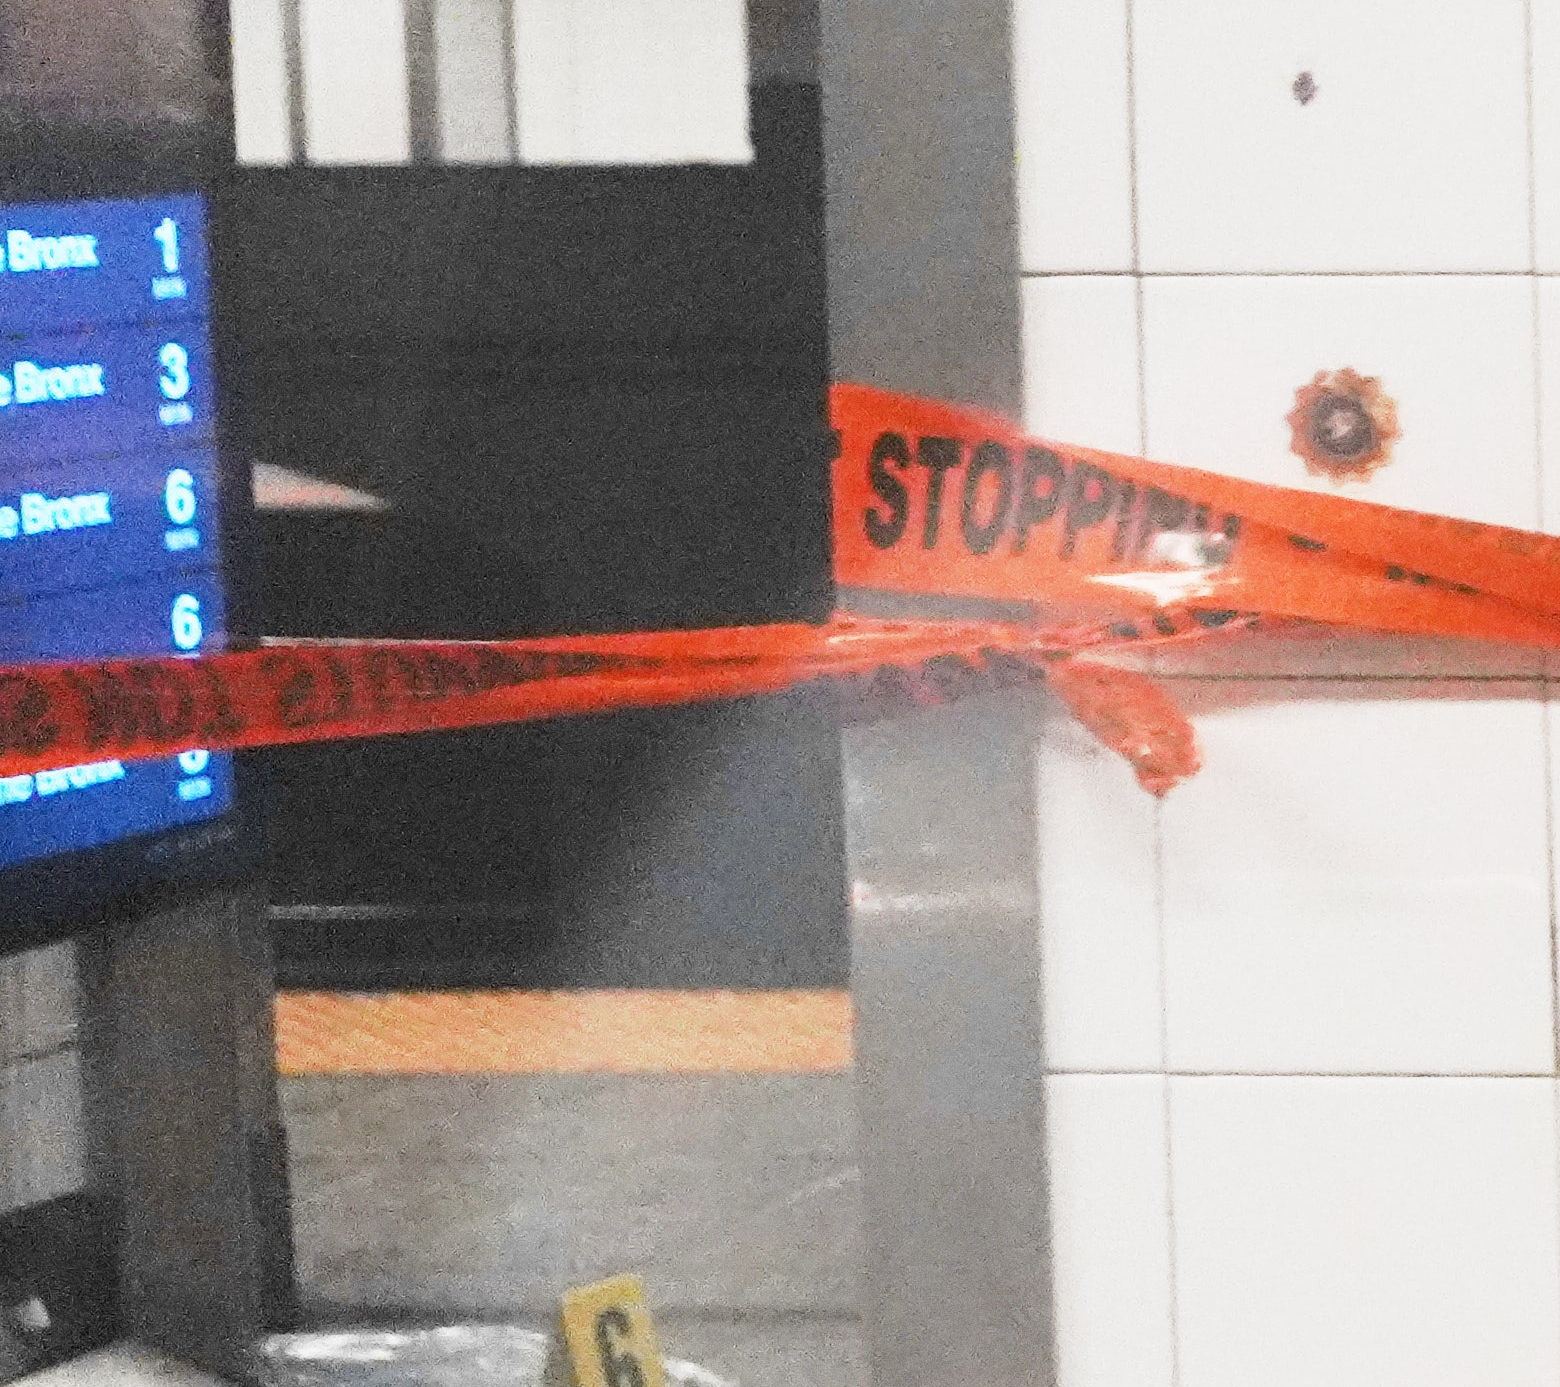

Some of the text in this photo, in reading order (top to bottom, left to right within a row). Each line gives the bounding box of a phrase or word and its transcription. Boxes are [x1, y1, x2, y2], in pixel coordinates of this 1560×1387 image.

[7, 217, 178, 273] Bronx 1
[14, 361, 105, 404] Bronx
[158, 342, 190, 400] 3
[20, 492, 113, 535] Bronx
[165, 468, 197, 525] 6
[171, 593, 202, 651] 6
